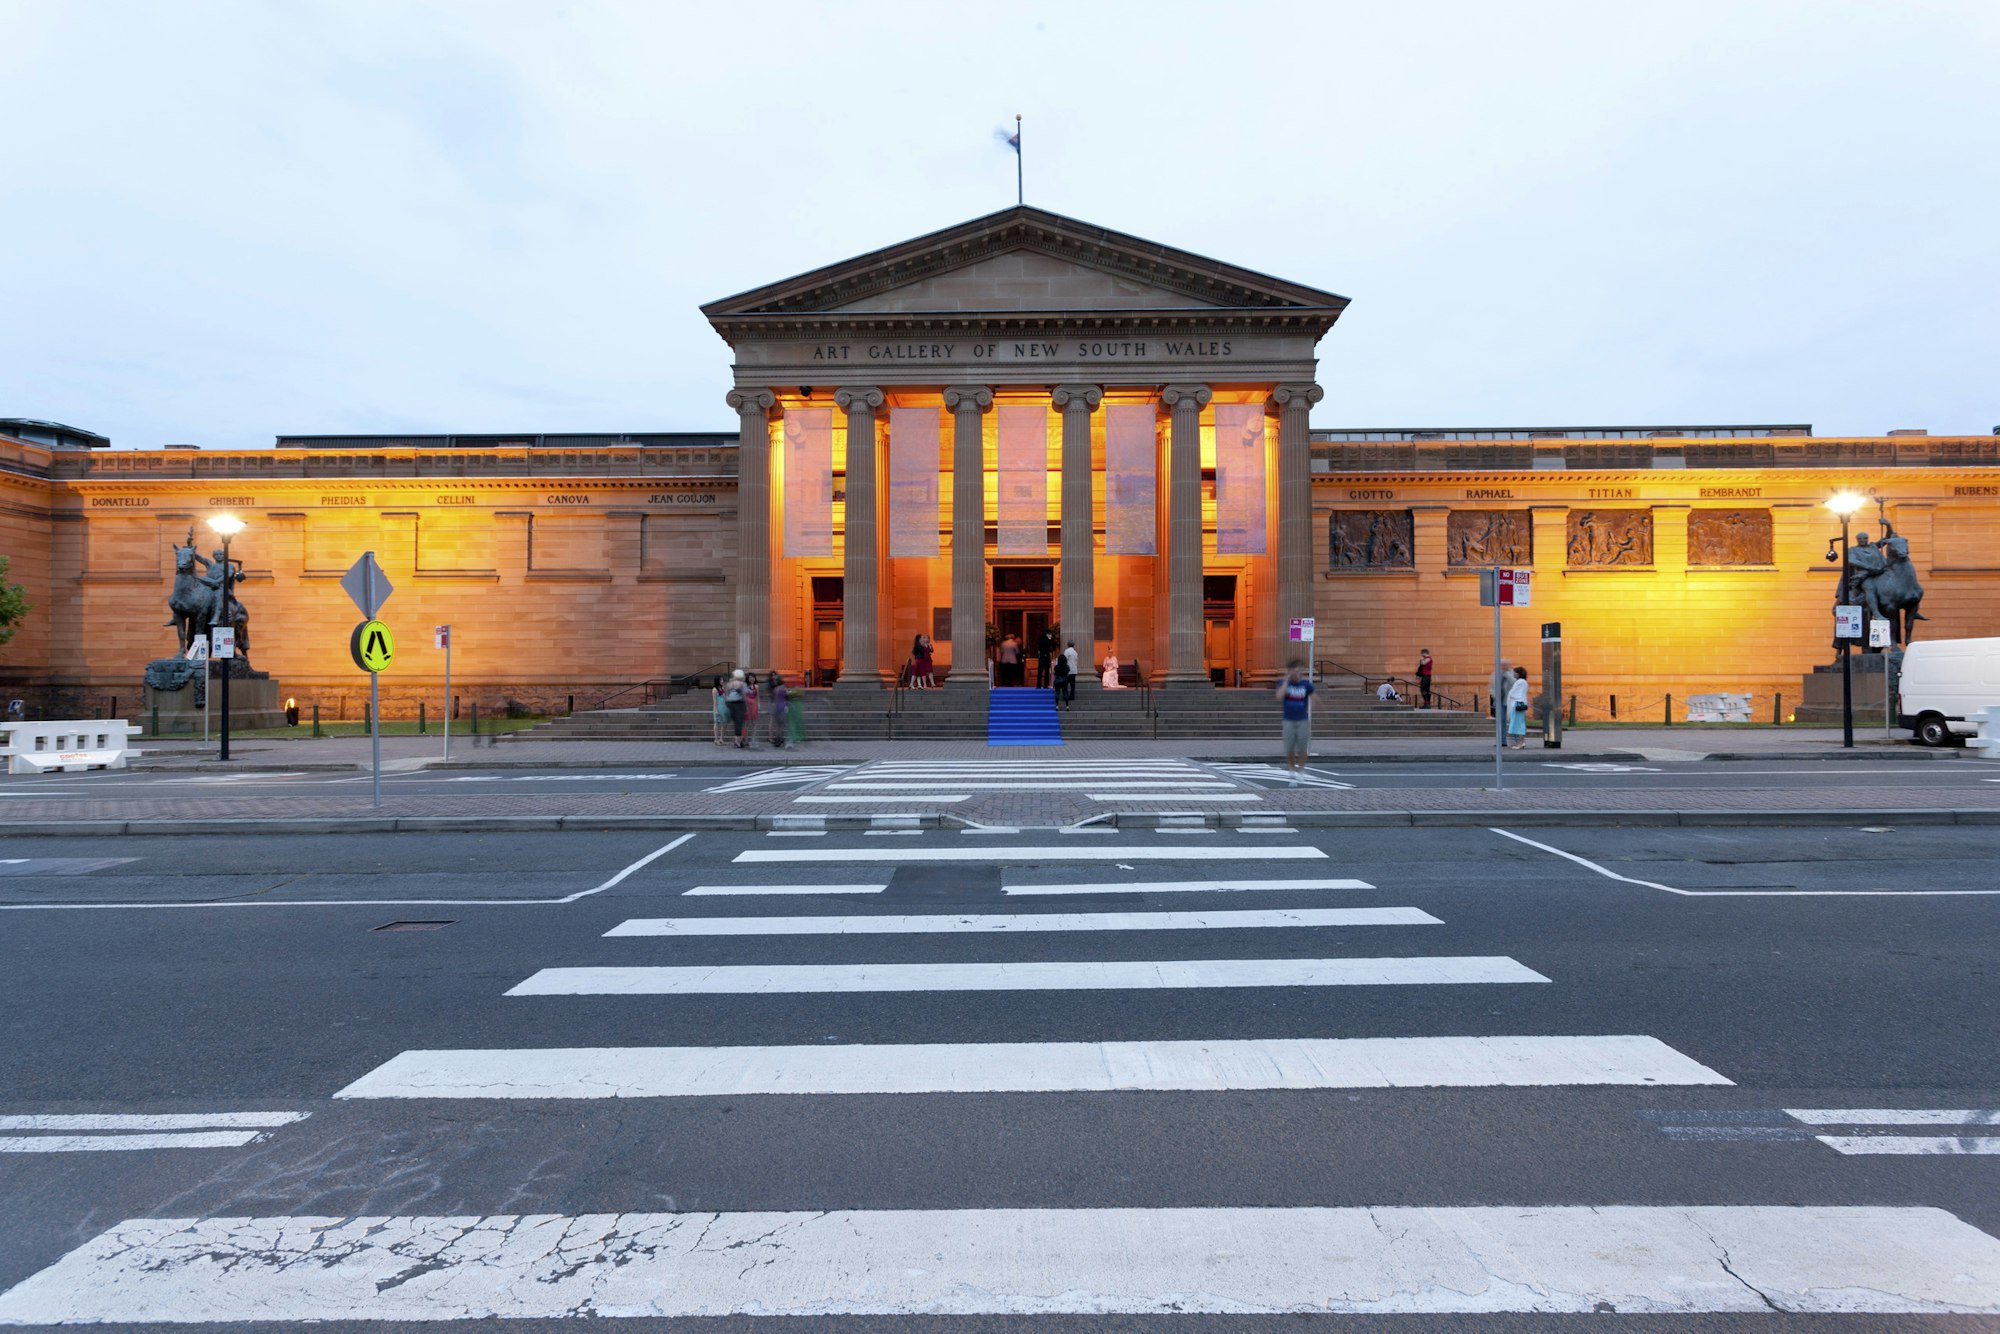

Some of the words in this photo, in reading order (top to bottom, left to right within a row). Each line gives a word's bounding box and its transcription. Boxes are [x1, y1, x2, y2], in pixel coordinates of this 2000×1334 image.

[813, 345, 850, 360] ART
[868, 345, 955, 359] GALLERY
[973, 344, 996, 358] OF
[1014, 343, 1060, 357] NEW
[1078, 343, 1147, 357] SOUTH
[1165, 342, 1232, 356] WALES
[1349, 490, 1394, 500] GIOTTO
[1466, 489, 1514, 499] RAPHAEL
[1588, 488, 1633, 498] TITIAN
[1699, 487, 1763, 497] REMBRANDT
[1954, 486, 1999, 496] RUBENS
[91, 497, 150, 507] DONATELLO
[208, 497, 255, 506] GHIBERTI
[320, 496, 367, 505] PHEIDIAS
[436, 495, 475, 505] CELLINI
[547, 495, 590, 504] CANOVA
[647, 494, 674, 504] JEAN
[676, 494, 717, 504] GOUJON
